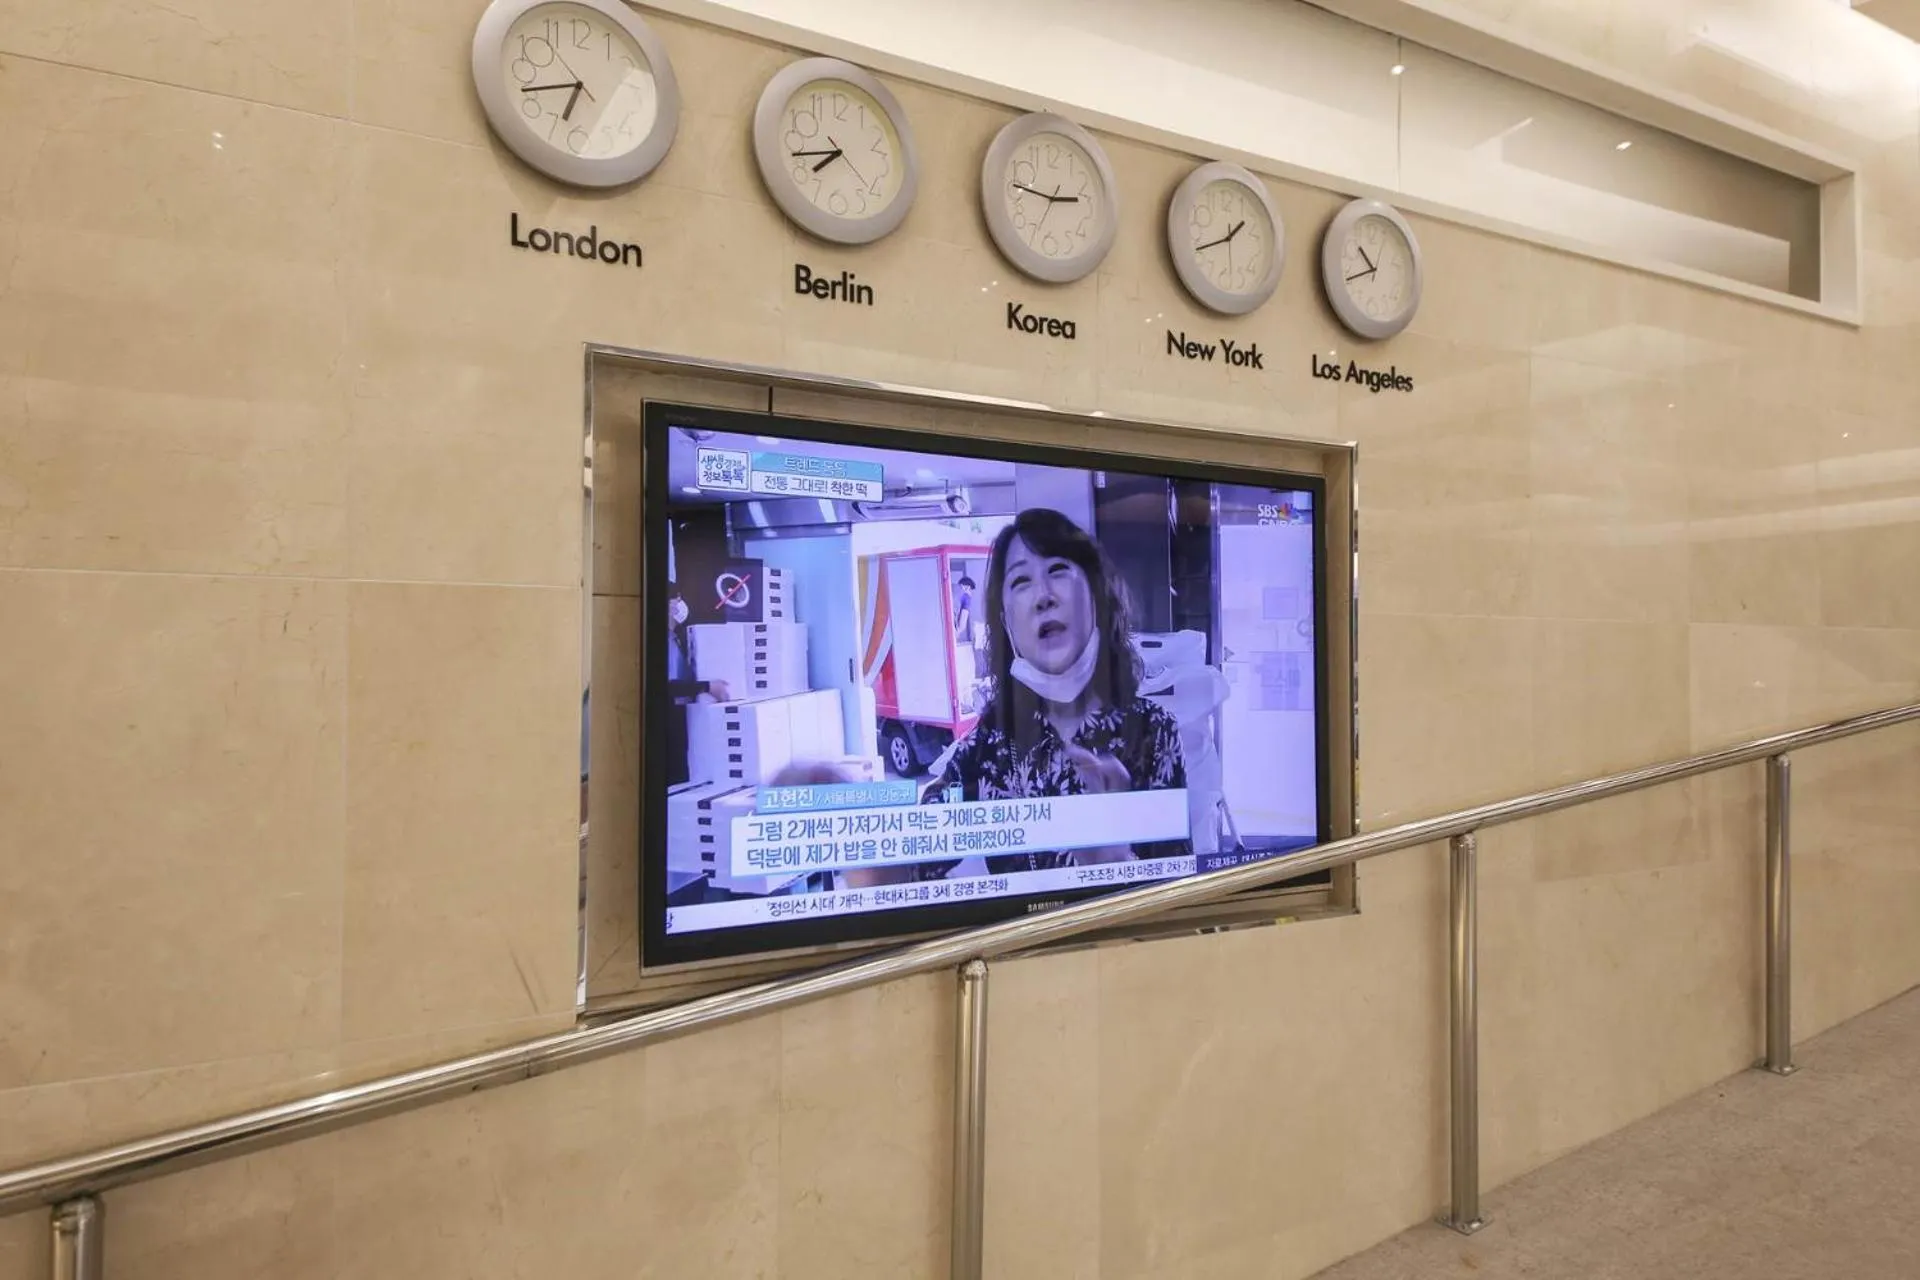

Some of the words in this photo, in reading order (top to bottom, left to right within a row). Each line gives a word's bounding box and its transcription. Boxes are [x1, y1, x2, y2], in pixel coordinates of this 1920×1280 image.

[542, 17, 559, 49] 11
[569, 17, 592, 51] 12
[603, 32, 612, 62] 1
[517, 34, 556, 68] 10
[810, 93, 824, 121] 11
[832, 93, 848, 122] 12
[858, 105, 865, 130] 1
[545, 111, 559, 142] 7
[790, 108, 819, 138] 10
[566, 124, 591, 154] 6
[811, 178, 821, 204] 7
[829, 188, 848, 215] 6
[511, 212, 642, 268] London
[794, 263, 874, 305] Berlin
[1006, 302, 1076, 339] Korea
[1167, 328, 1217, 361] New
[1219, 339, 1264, 370] York
[1312, 354, 1342, 381] Los
[1344, 360, 1414, 394] Angeles
[830, 480, 854, 496] 착한
[855, 482, 868, 498] 떡
[1257, 503, 1278, 518] SBS
[763, 788, 815, 809] 고현진
[747, 820, 783, 843] 그럼
[787, 817, 834, 840] 2개씩
[837, 812, 904, 836] 가져가서
[908, 812, 938, 831] 먹는
[943, 807, 988, 828] 거예요
[991, 804, 1020, 824] 회사
[1023, 802, 1052, 822] 가서
[747, 847, 800, 870] 덕분에
[806, 840, 840, 865] 제가
[844, 838, 878, 862] 밥을
[881, 837, 898, 858] 안
[902, 833, 948, 857] 해줘서
[952, 827, 1027, 852] 편해졌어요
[1117, 864, 1136, 879] 시장
[932, 883, 951, 899] 3세
[952, 881, 975, 897] 경영
